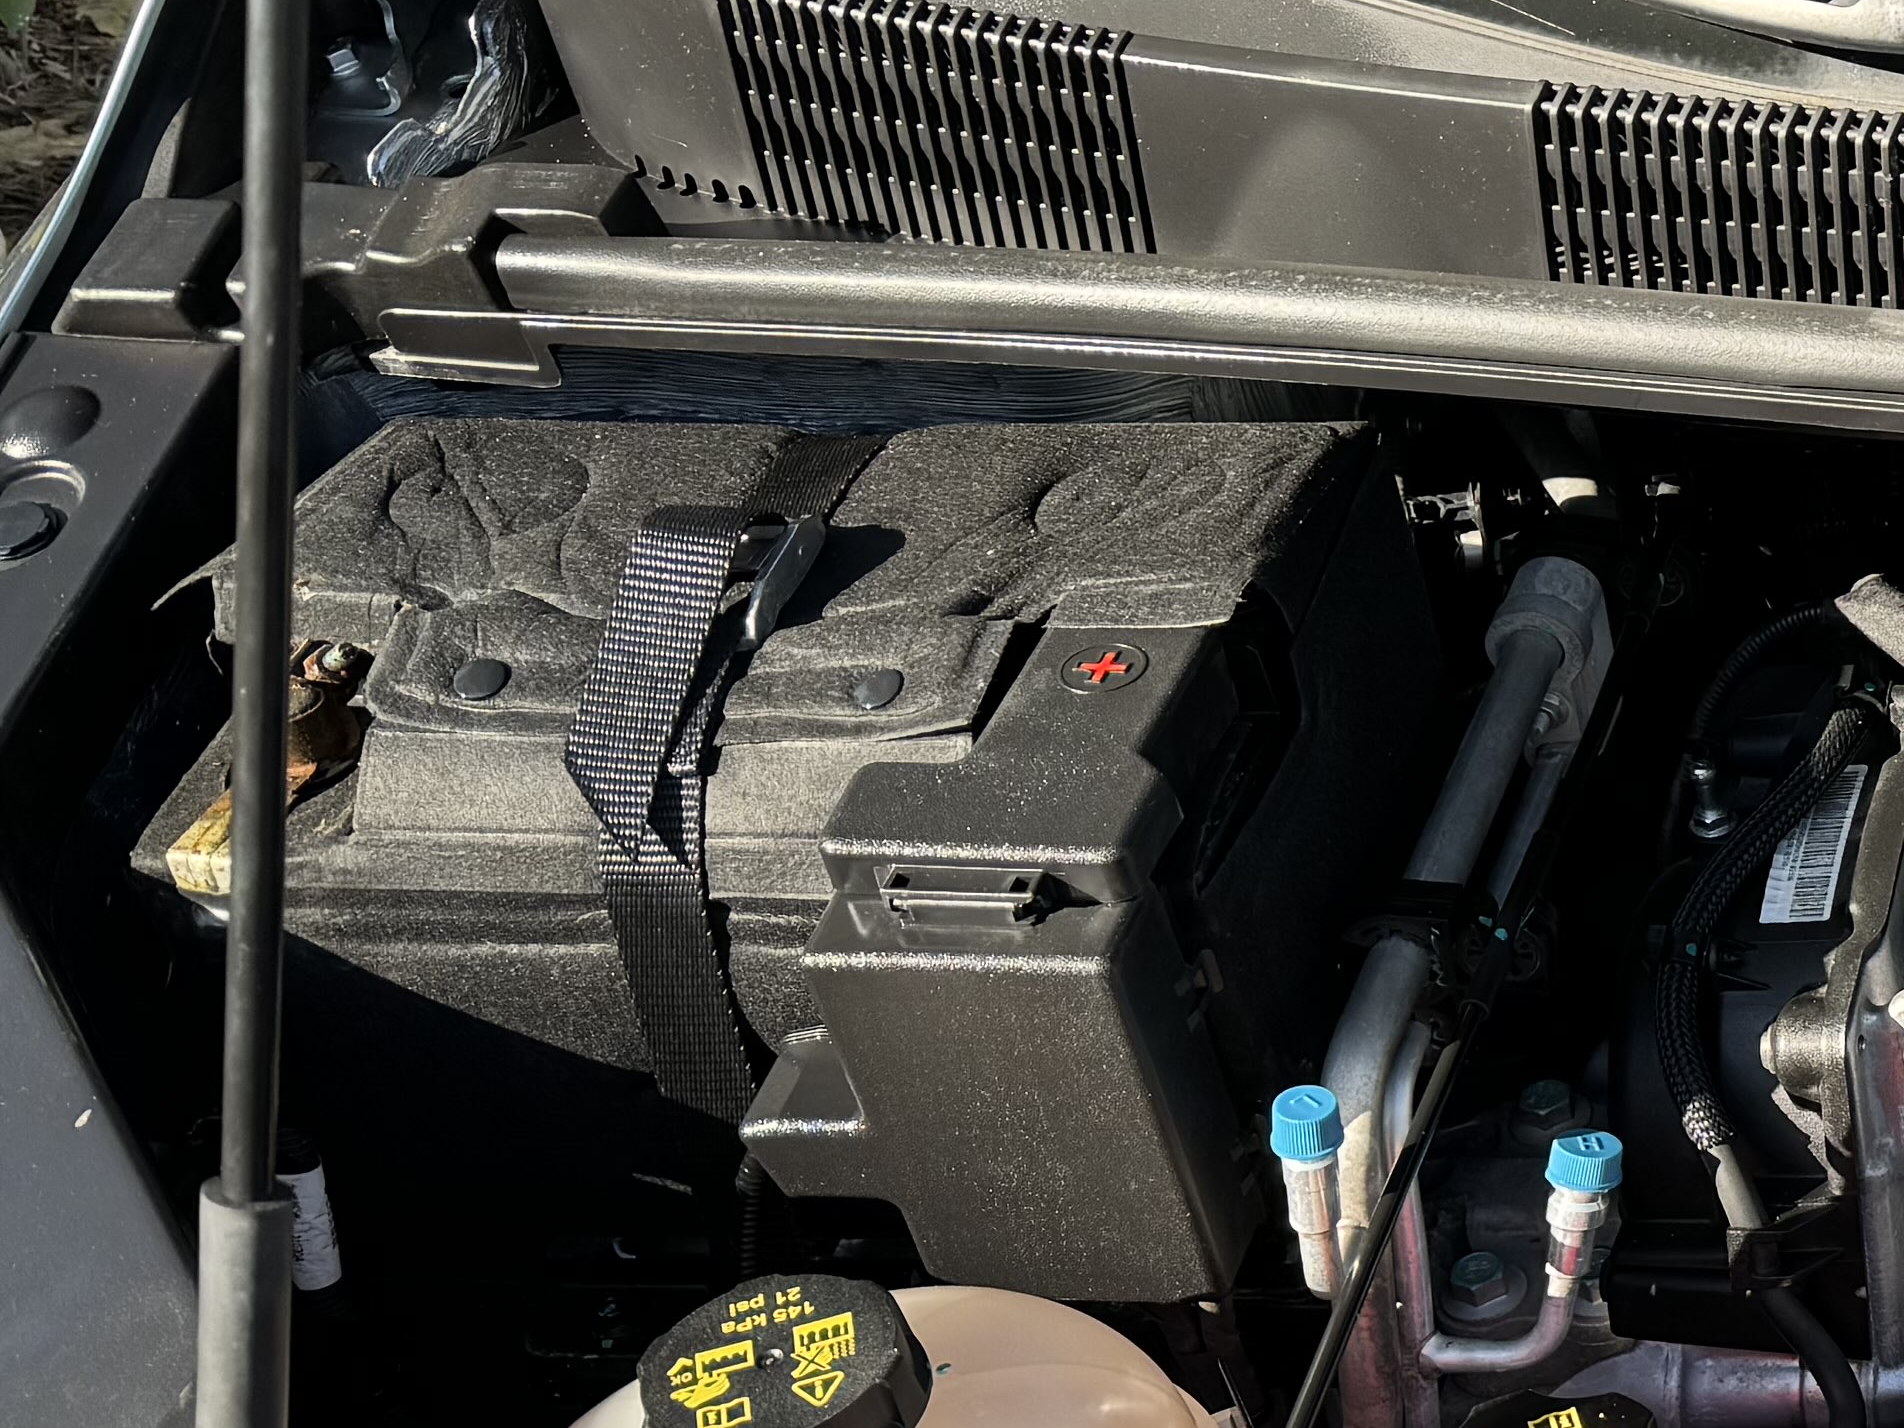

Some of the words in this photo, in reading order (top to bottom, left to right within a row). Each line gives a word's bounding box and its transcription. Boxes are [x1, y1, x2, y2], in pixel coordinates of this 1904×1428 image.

[1577, 1135, 1604, 1152] H
[775, 1285, 802, 1304] 21
[728, 1292, 766, 1318] psi
[772, 1300, 815, 1325] 145
[720, 1313, 768, 1335] kPa
[670, 1371, 694, 1387] OK
